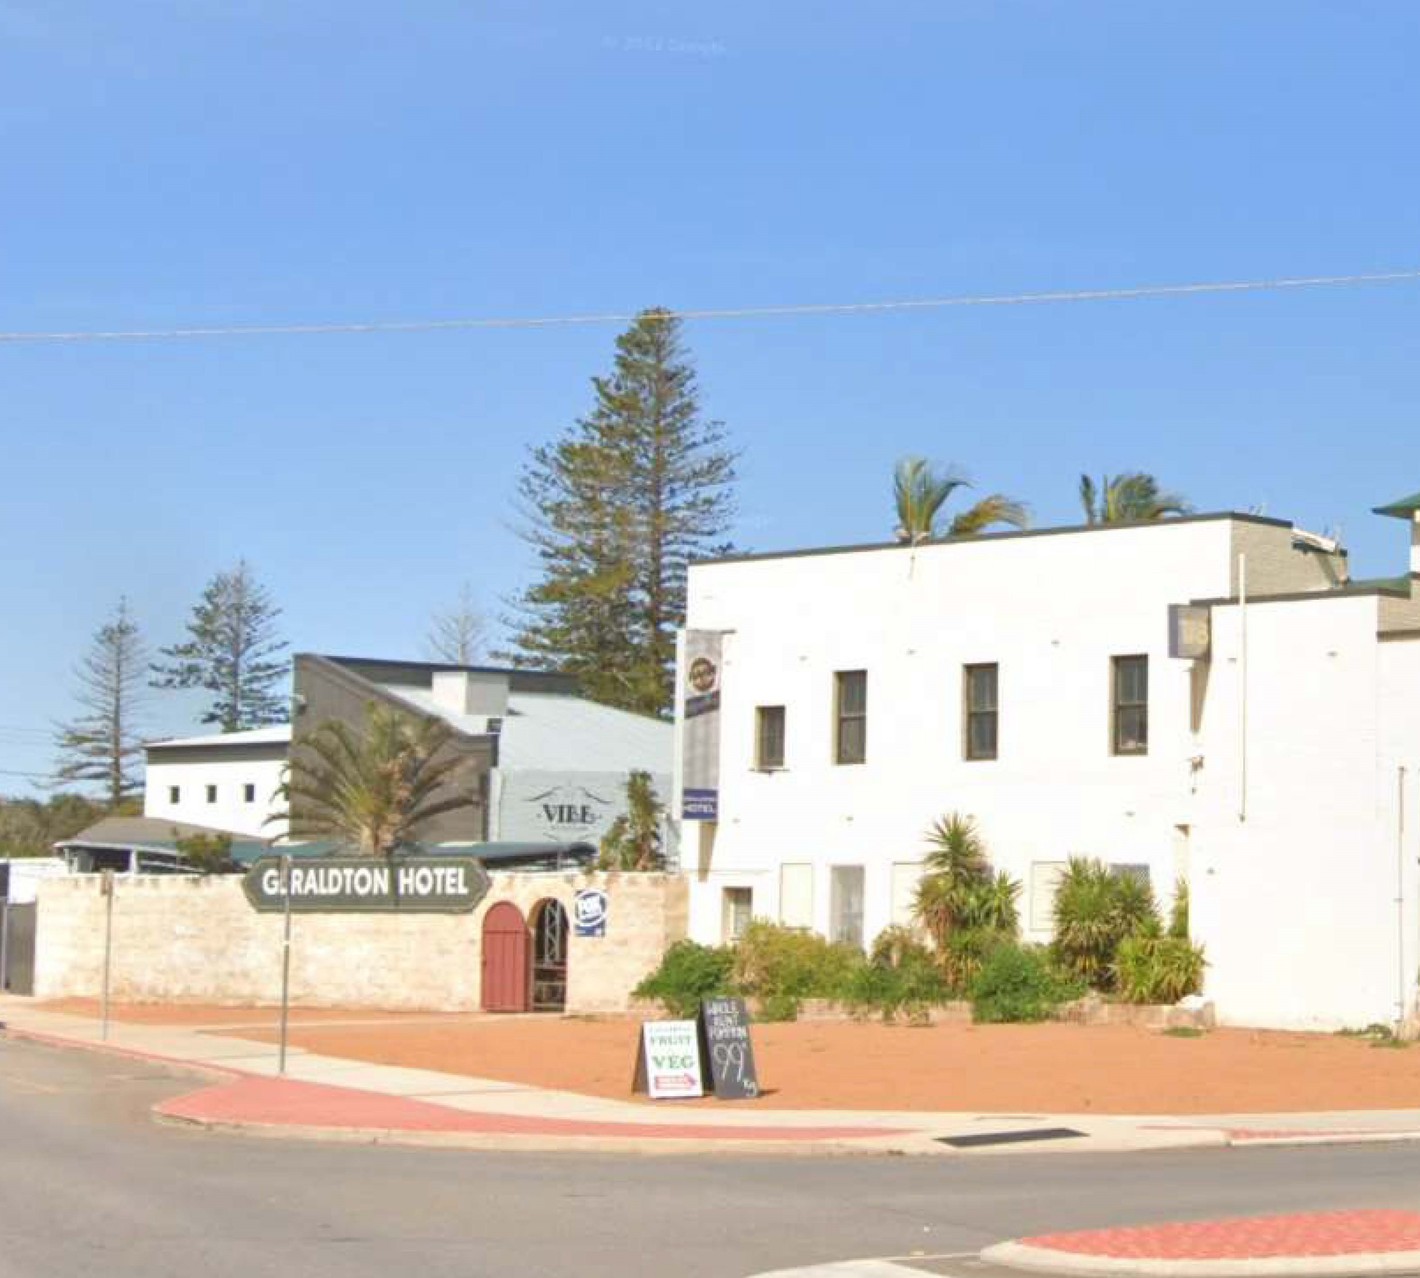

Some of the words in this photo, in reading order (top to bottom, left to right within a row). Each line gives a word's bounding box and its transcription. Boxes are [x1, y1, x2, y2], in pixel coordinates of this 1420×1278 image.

[262, 868, 389, 895] GRALDTON
[399, 867, 469, 895] HOTEL
[652, 1055, 696, 1070] VEG
